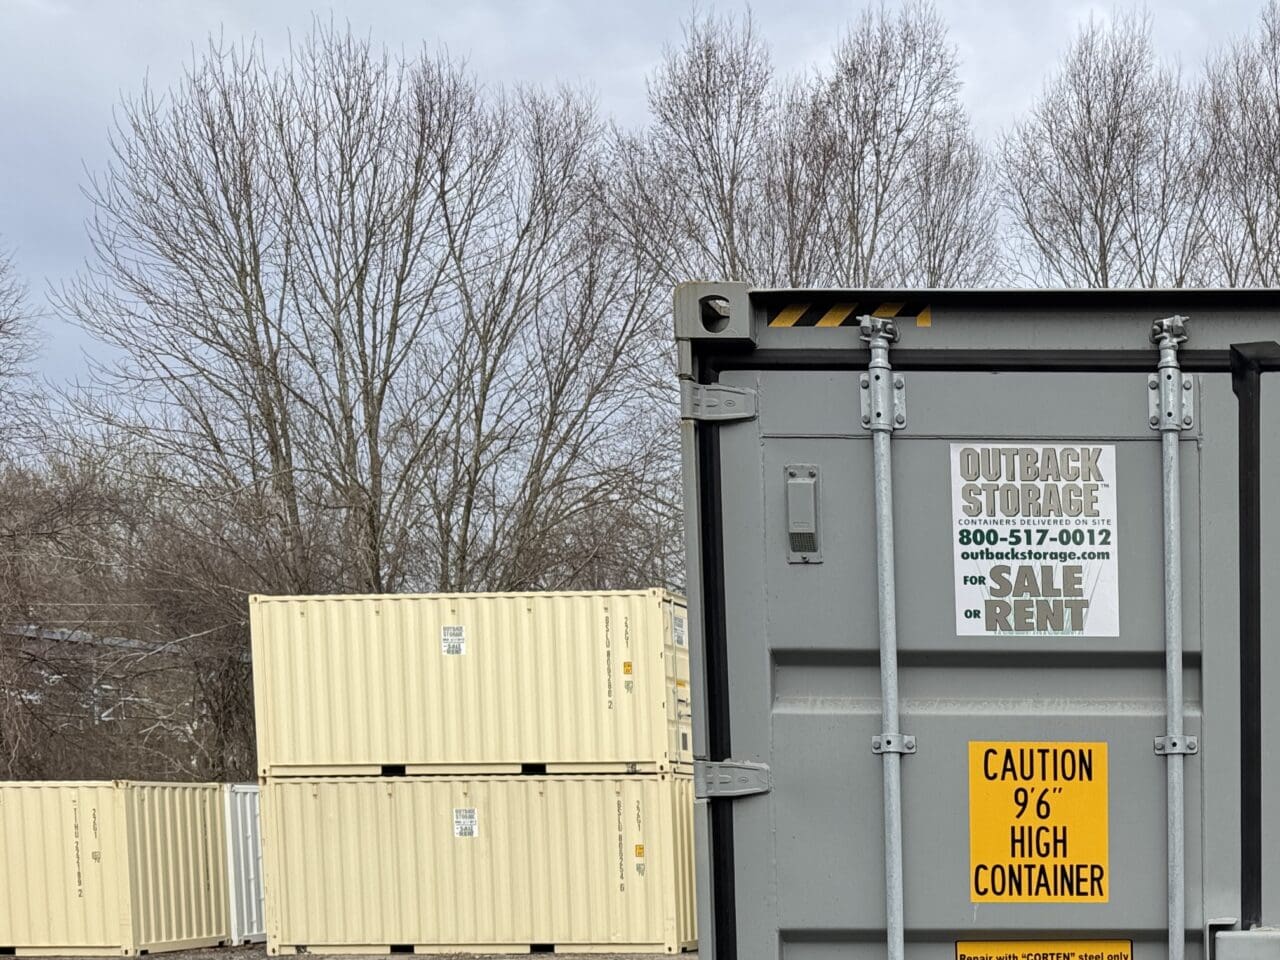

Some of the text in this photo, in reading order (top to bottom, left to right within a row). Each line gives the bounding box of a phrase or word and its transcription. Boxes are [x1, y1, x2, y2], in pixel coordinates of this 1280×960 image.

[960, 448, 1104, 482] OUTBACK
[961, 483, 1100, 517] STORAGE
[959, 529, 1111, 545] 800-517-0012
[961, 548, 1110, 562] outbackstorage.com
[964, 565, 1083, 597] FOR SALE
[964, 600, 1089, 631] OR RENT
[984, 748, 1092, 781] CAUTION
[1010, 826, 1067, 858] HIGH
[974, 864, 1104, 896] CONTAINER
